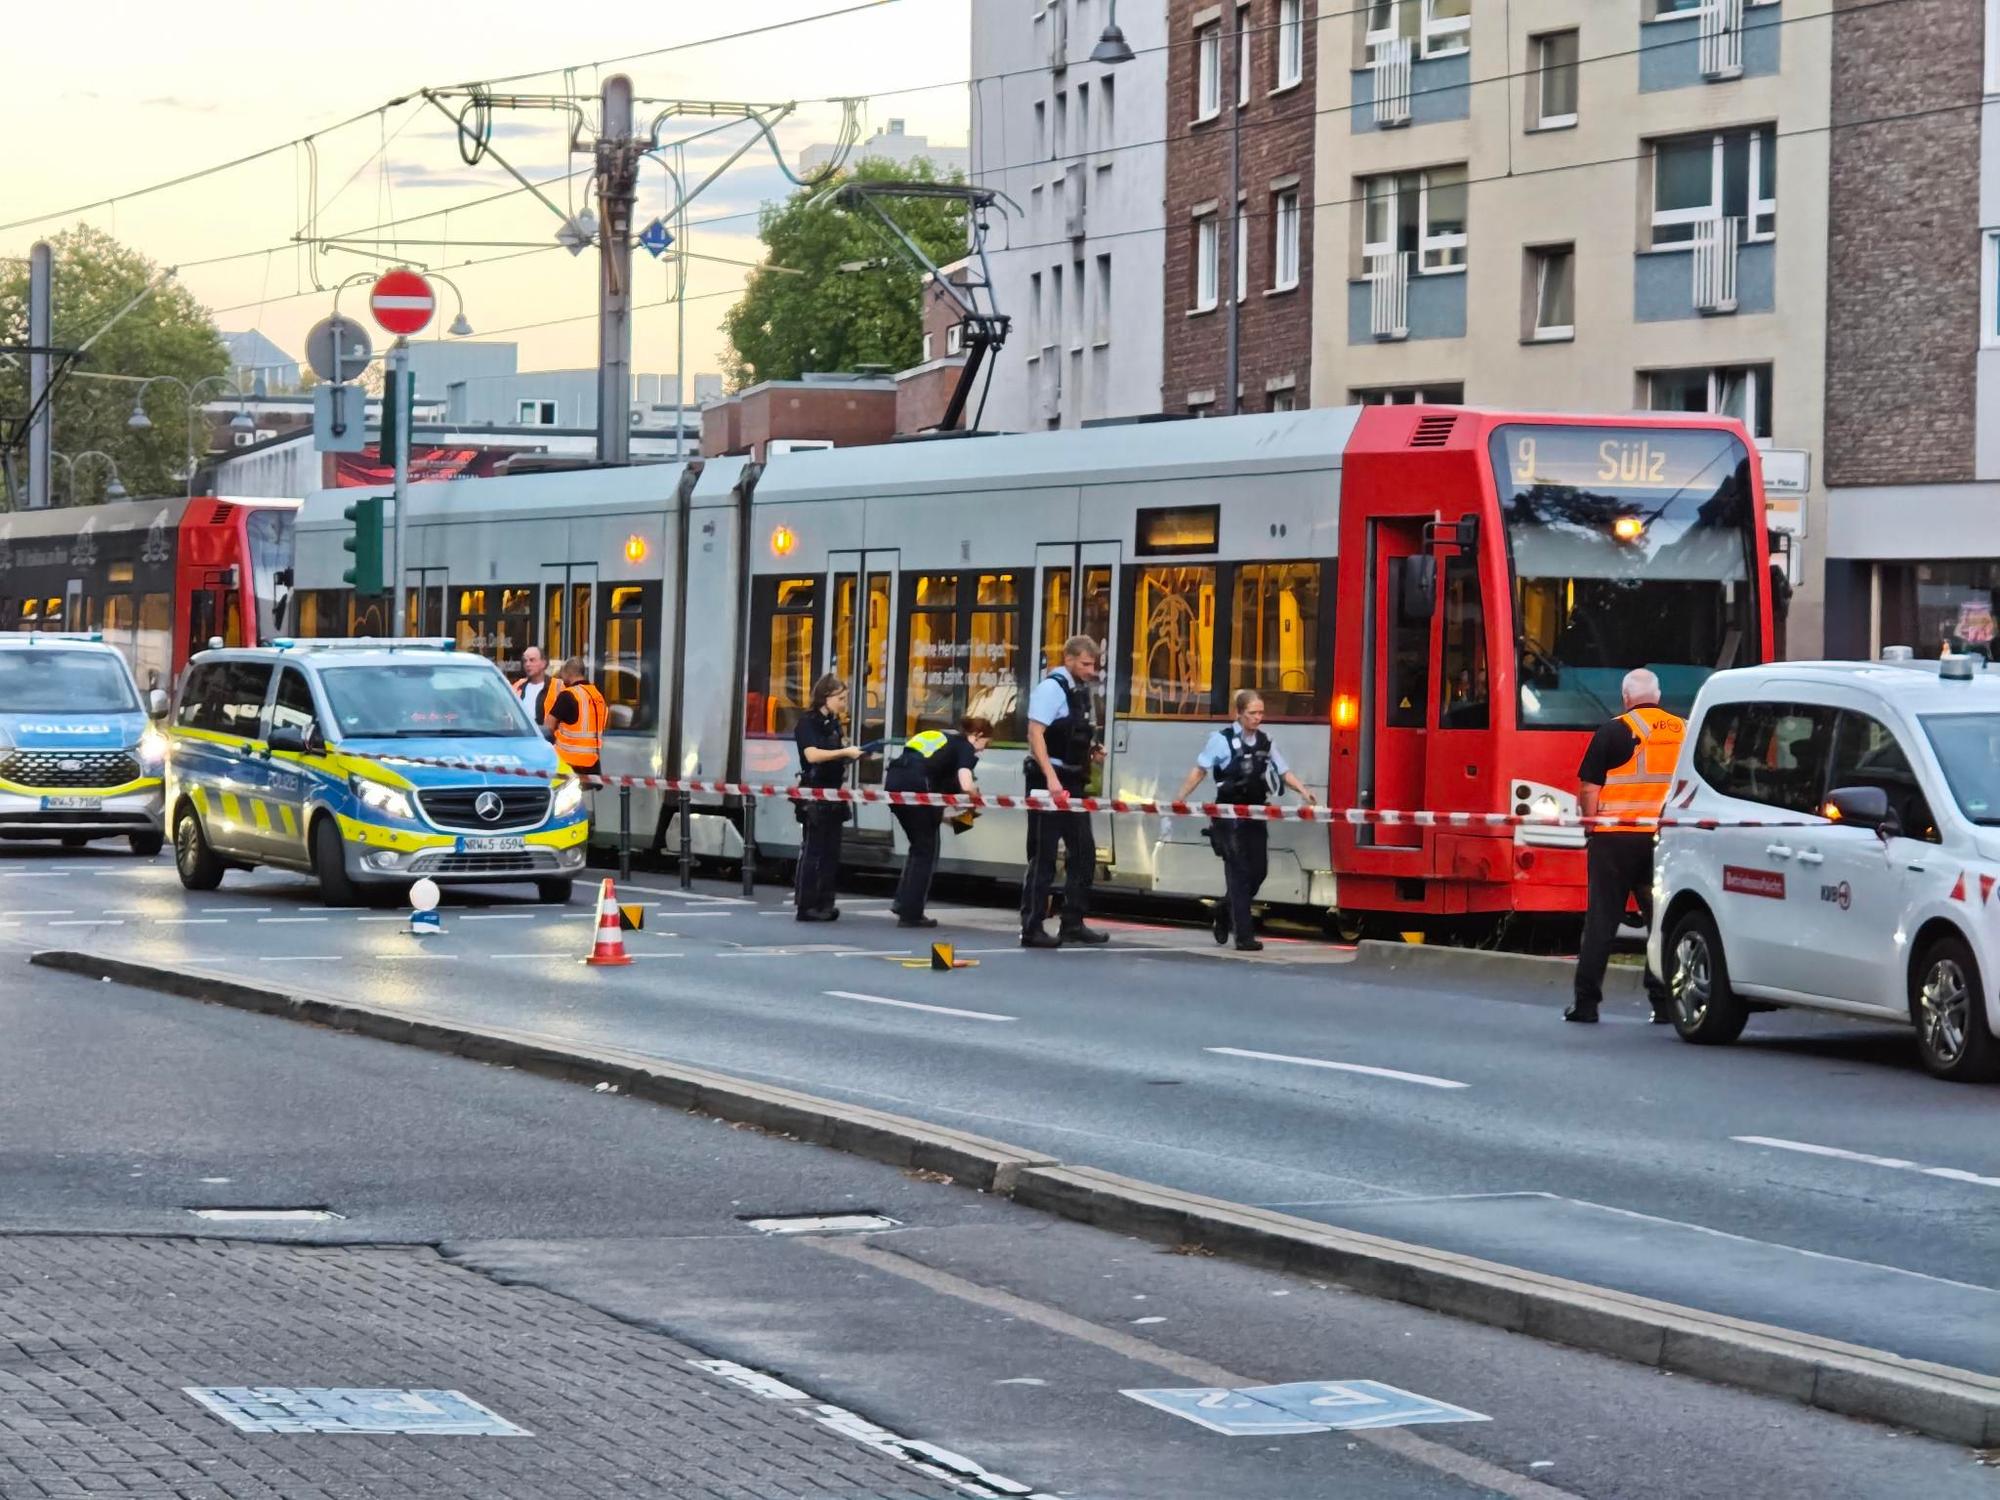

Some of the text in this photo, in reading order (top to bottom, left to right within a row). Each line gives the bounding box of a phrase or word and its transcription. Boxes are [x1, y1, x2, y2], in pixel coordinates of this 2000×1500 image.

[1517, 437, 1667, 483] 9 Sülz
[19, 723, 110, 735] POLIZEI
[499, 837, 524, 849] 6594
